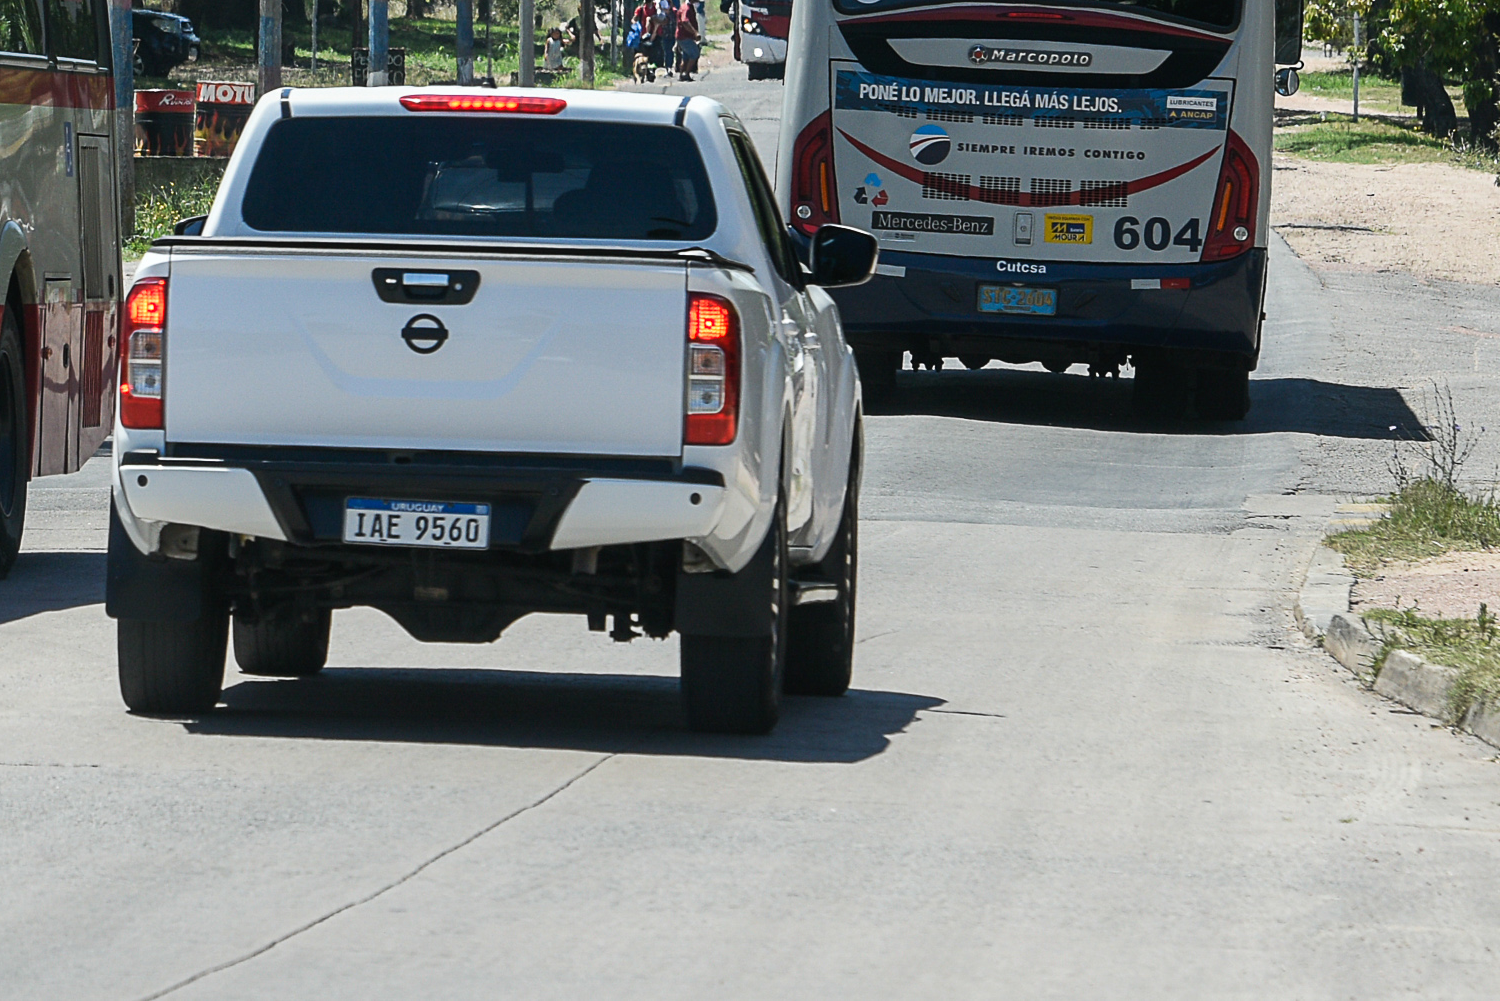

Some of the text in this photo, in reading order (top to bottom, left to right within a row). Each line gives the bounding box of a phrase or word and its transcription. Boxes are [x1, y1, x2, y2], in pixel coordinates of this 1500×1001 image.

[991, 48, 1092, 66] Marcopolo
[858, 83, 1122, 113] PONÉ LO MEJOR. LLEGÁ MÁS LEJOS.
[1181, 111, 1213, 119] ANCAP
[957, 142, 1146, 161] SIEMPRE IREMOS CONTIGO
[878, 213, 988, 233] Mercedes-Benz
[1052, 233, 1086, 242] MOURA
[1113, 216, 1202, 252] 604
[996, 261, 1047, 274] Cutcsa
[391, 502, 444, 513] URUGUAY
[354, 513, 479, 543] IAE 9560
